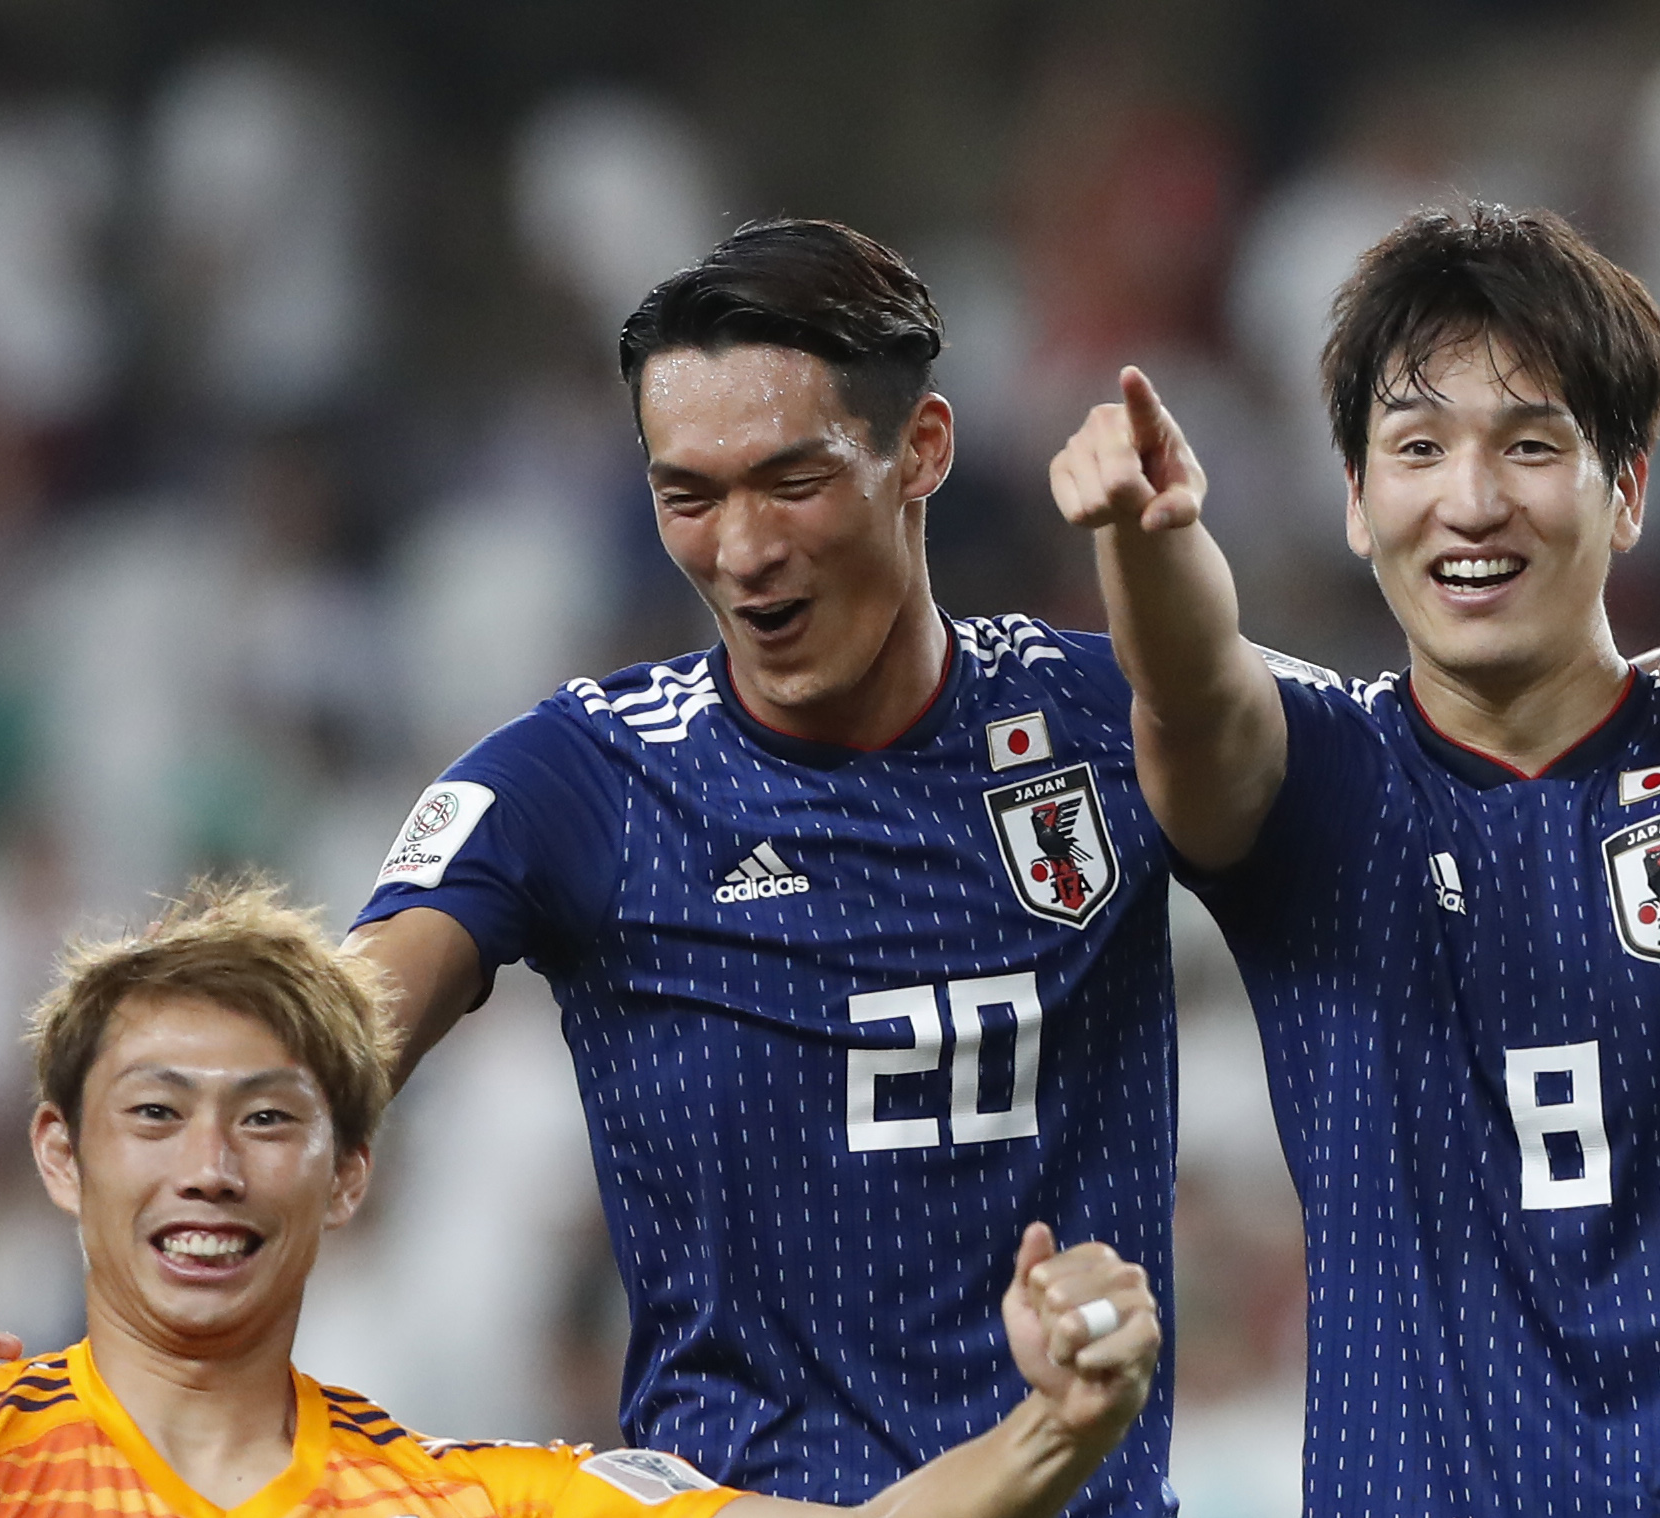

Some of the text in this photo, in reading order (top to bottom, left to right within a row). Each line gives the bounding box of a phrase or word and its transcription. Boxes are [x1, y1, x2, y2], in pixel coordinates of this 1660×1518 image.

[1014, 776, 1067, 802] JAPAN
[410, 853, 442, 865] CUP
[715, 874, 810, 903] adidas
[1050, 874, 1094, 903] JFA
[846, 972, 1040, 1153] 20
[1505, 1040, 1613, 1210] 8
